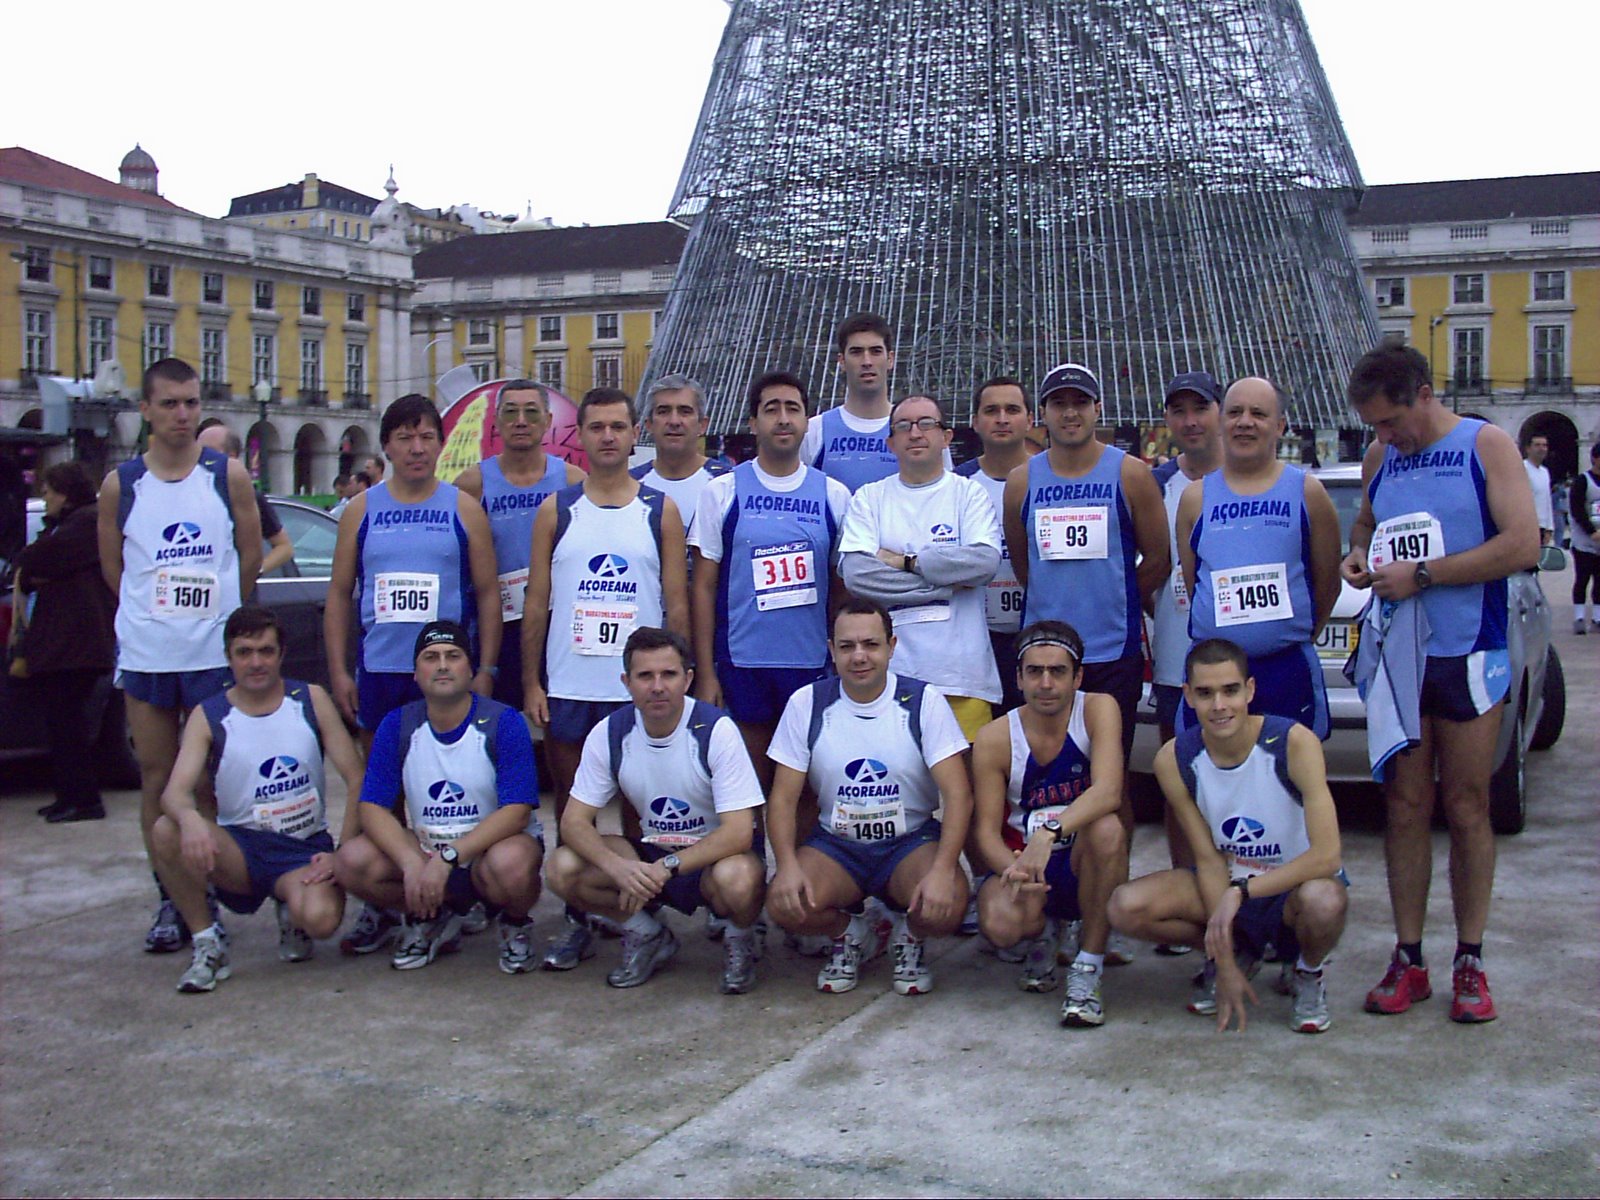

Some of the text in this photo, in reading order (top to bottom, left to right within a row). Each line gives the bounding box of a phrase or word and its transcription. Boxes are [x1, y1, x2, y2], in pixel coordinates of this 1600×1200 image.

[744, 495, 820, 515] AÇOREANA
[1034, 484, 1112, 506] AÇOREANA
[373, 509, 449, 528] AÇOREANA
[1209, 501, 1290, 524] AÇOREANA
[1066, 526, 1087, 547] 93
[156, 544, 213, 562] AÇOREANA
[755, 545, 790, 557] Reebok
[1388, 533, 1428, 561] 1497
[762, 556, 806, 585] 316
[173, 586, 210, 608] 1501
[578, 580, 637, 594] AÇOREANA
[1236, 584, 1279, 610] 1496
[390, 590, 428, 610] 1505
[1001, 591, 1021, 611] 96
[599, 622, 619, 643] 97
[255, 774, 310, 799] AÇOREANA
[837, 784, 899, 800] AÇOREANA
[423, 804, 479, 820] AÇOREANA
[648, 816, 705, 832] AÇOREANA
[853, 821, 896, 840] 1499
